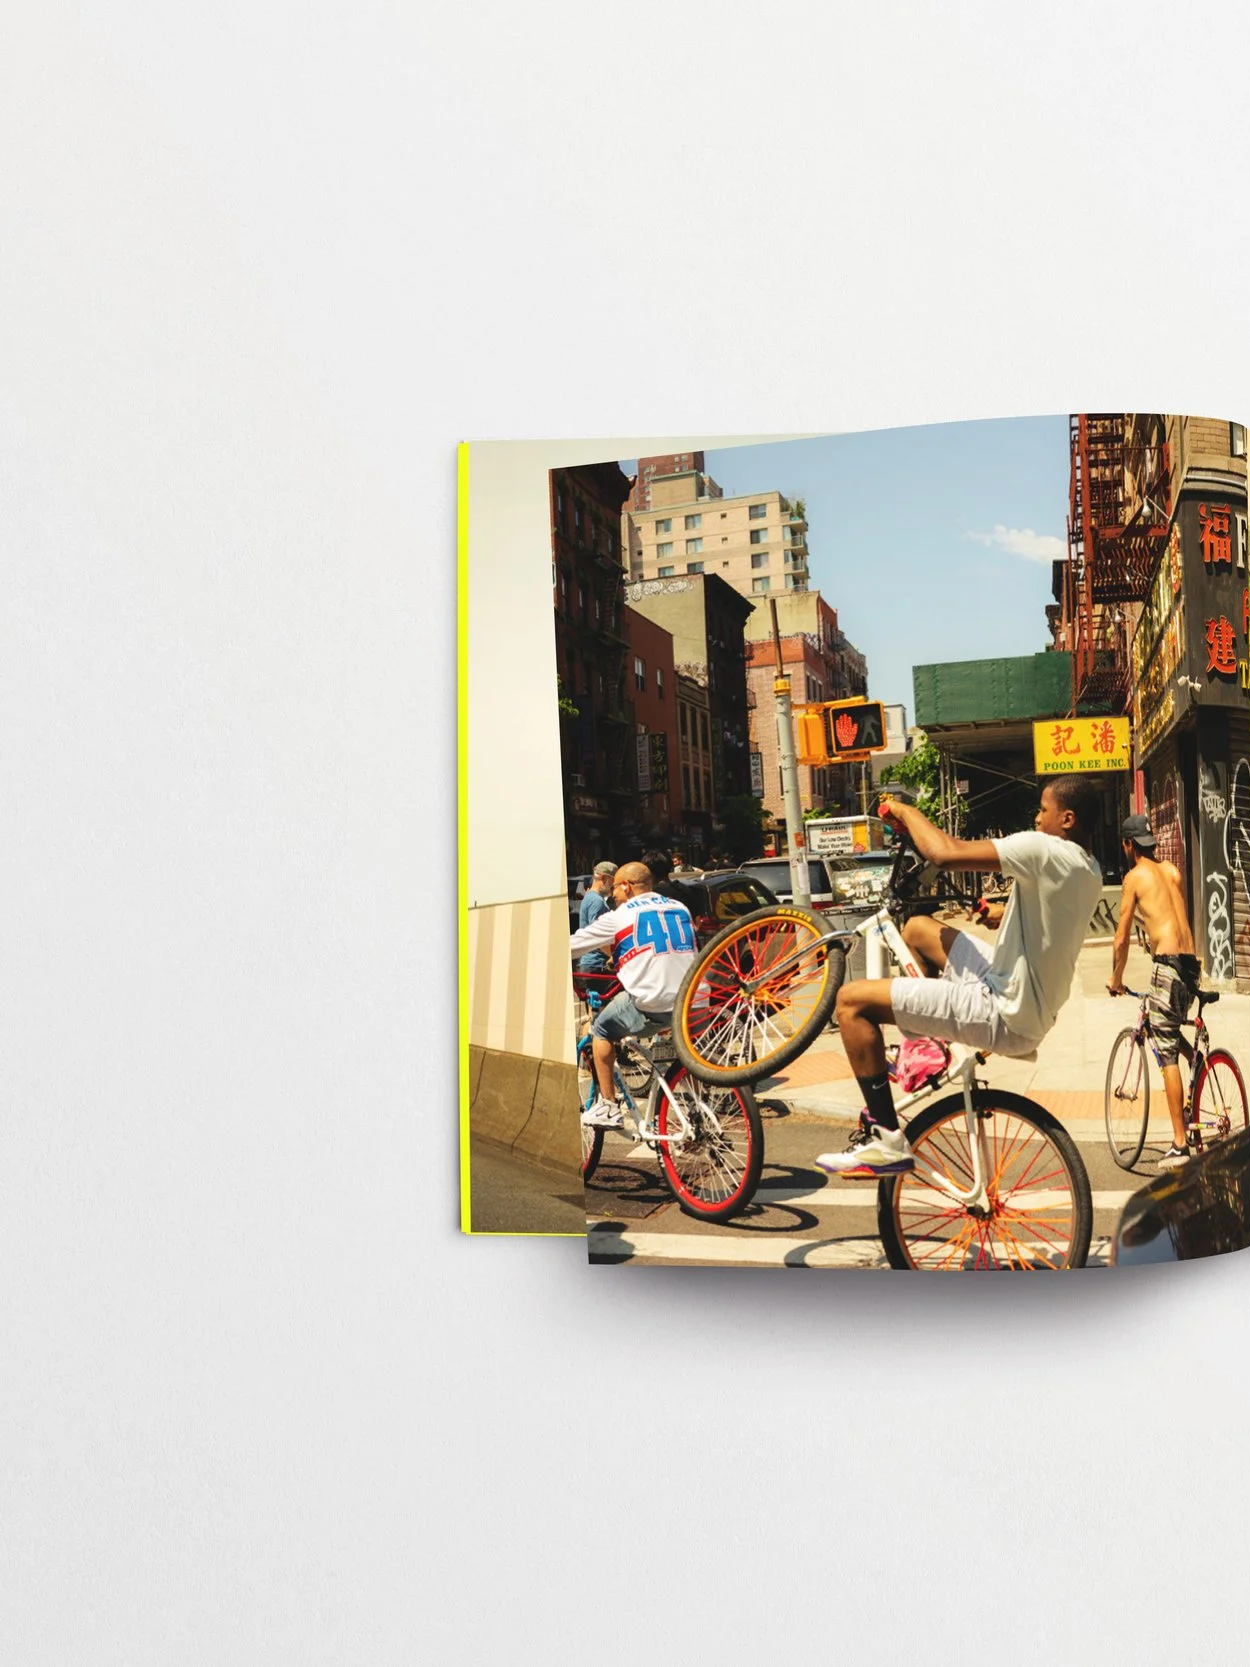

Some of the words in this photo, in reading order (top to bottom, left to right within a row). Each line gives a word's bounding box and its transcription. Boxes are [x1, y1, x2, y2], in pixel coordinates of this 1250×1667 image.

[1043, 761, 1074, 771] POON
[1079, 759, 1101, 769] KEE
[1106, 758, 1127, 768] INC.
[776, 908, 813, 922] MAXXIS
[635, 908, 696, 955] 40
